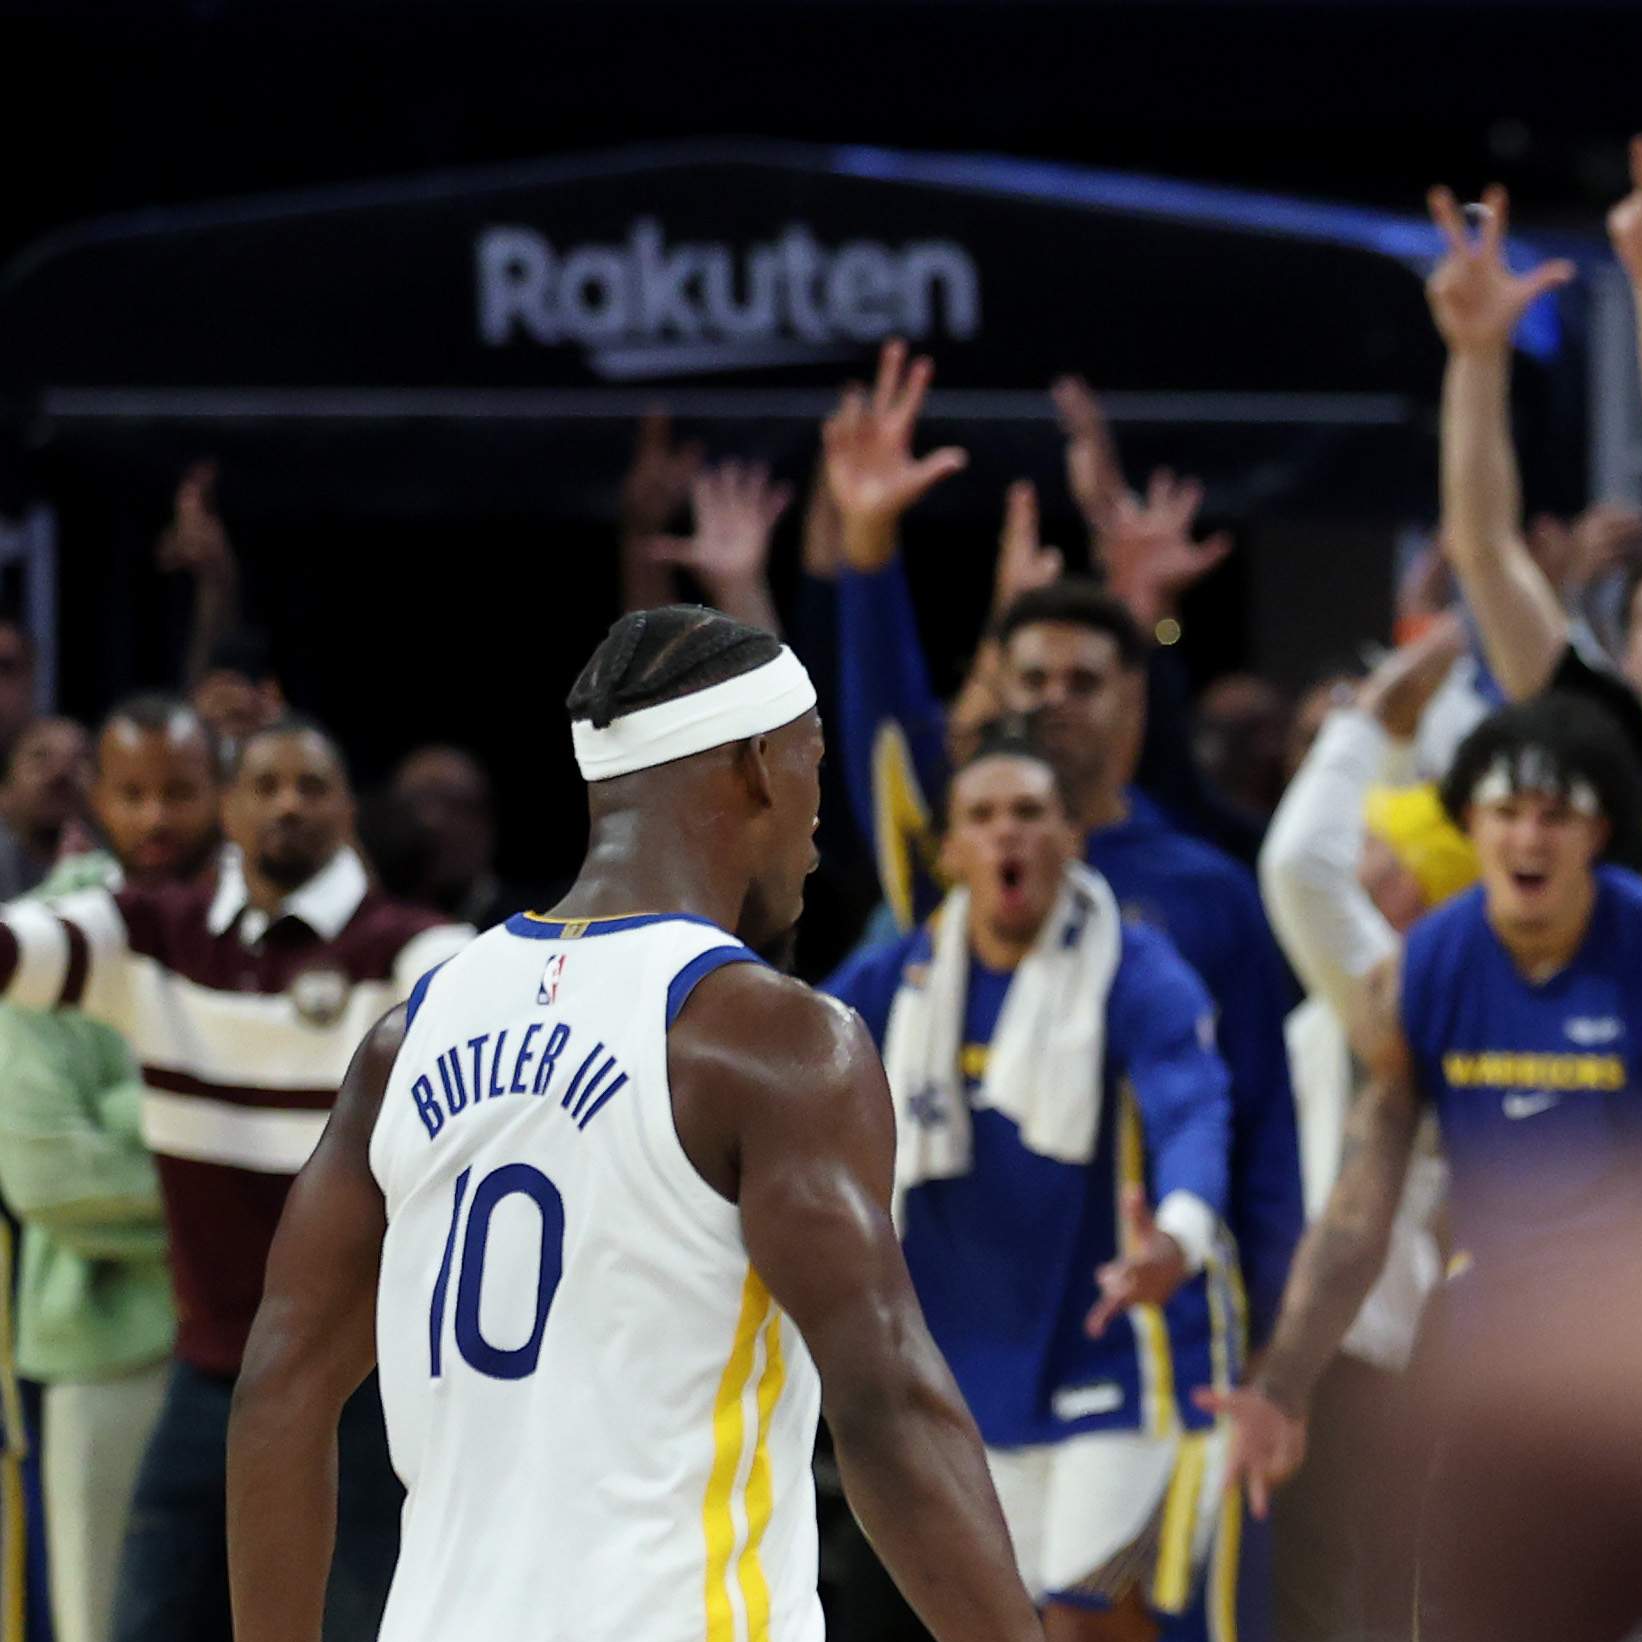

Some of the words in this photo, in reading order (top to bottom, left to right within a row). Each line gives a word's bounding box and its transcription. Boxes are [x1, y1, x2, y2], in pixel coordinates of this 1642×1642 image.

[475, 218, 980, 348] Rakuten
[411, 1023, 571, 1140] BUTLER
[561, 1041, 629, 1131] III
[430, 1163, 565, 1381] 10
